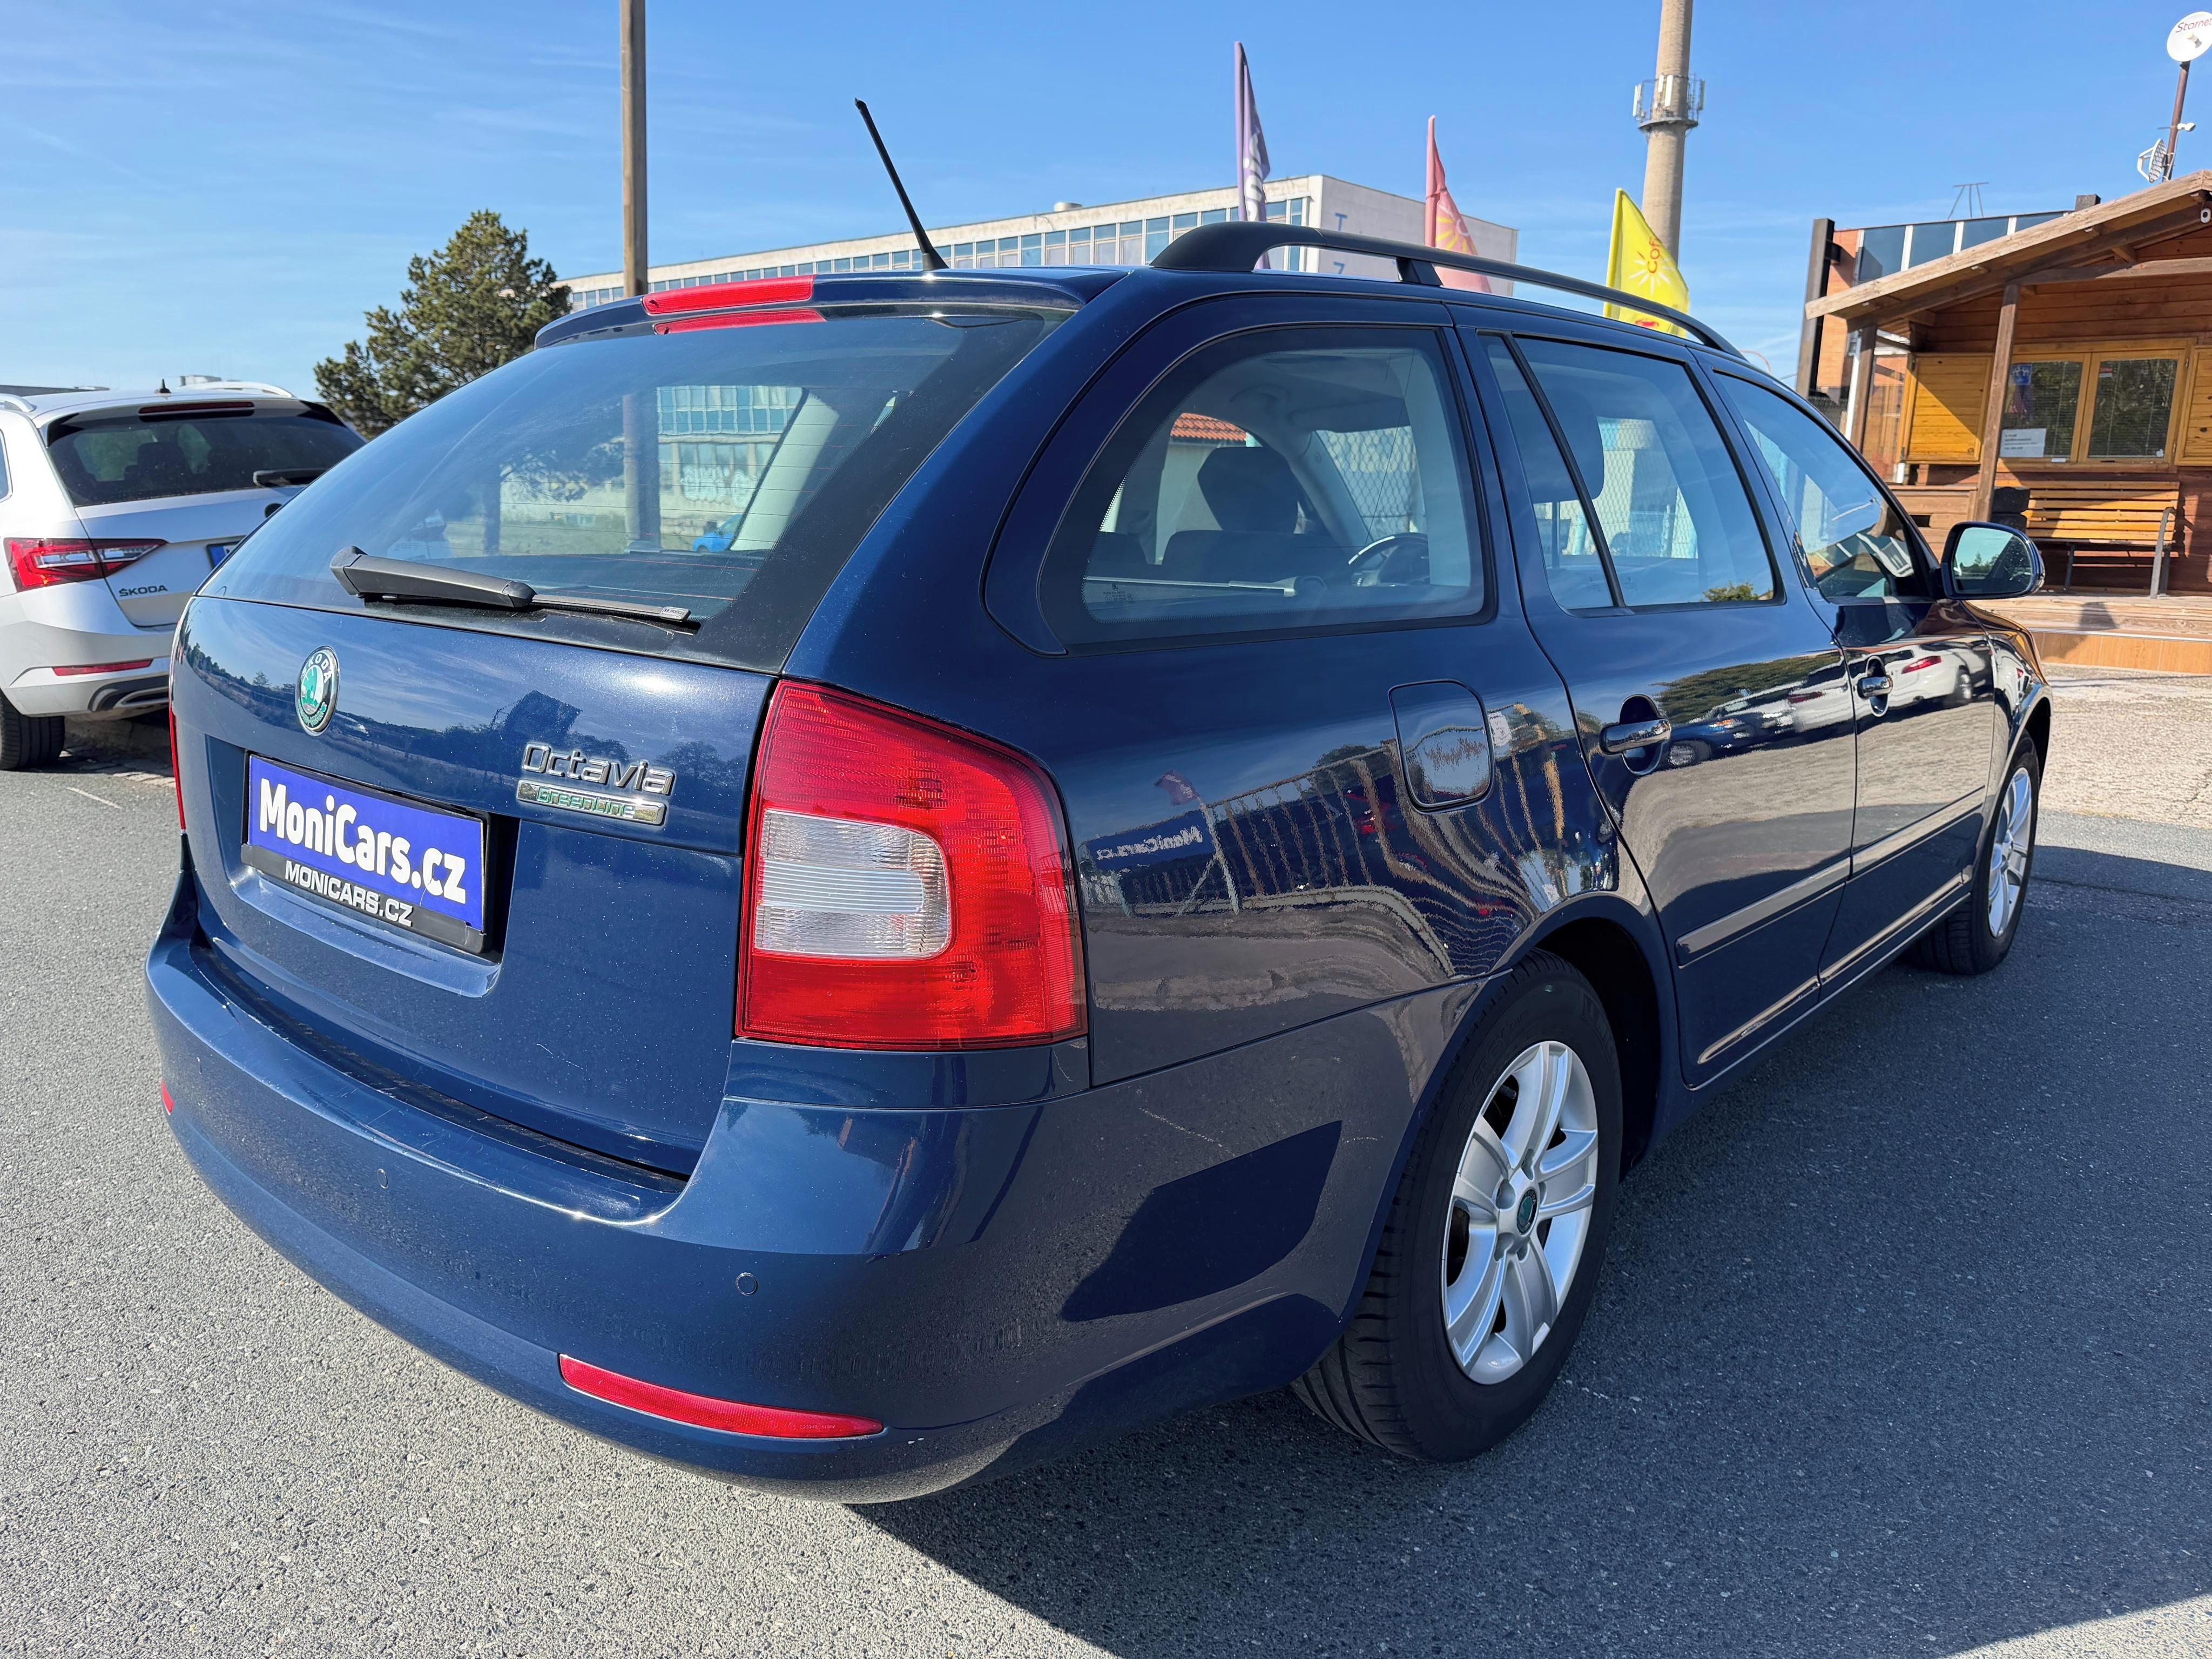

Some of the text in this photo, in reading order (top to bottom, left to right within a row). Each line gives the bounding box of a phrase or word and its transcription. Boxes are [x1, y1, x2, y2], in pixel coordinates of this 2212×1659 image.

[118, 585, 168, 597] ŠKODA
[522, 742, 675, 795] Octavia
[260, 778, 467, 905] MoniCars.cz
[285, 860, 414, 927] MONICARS.CZ
